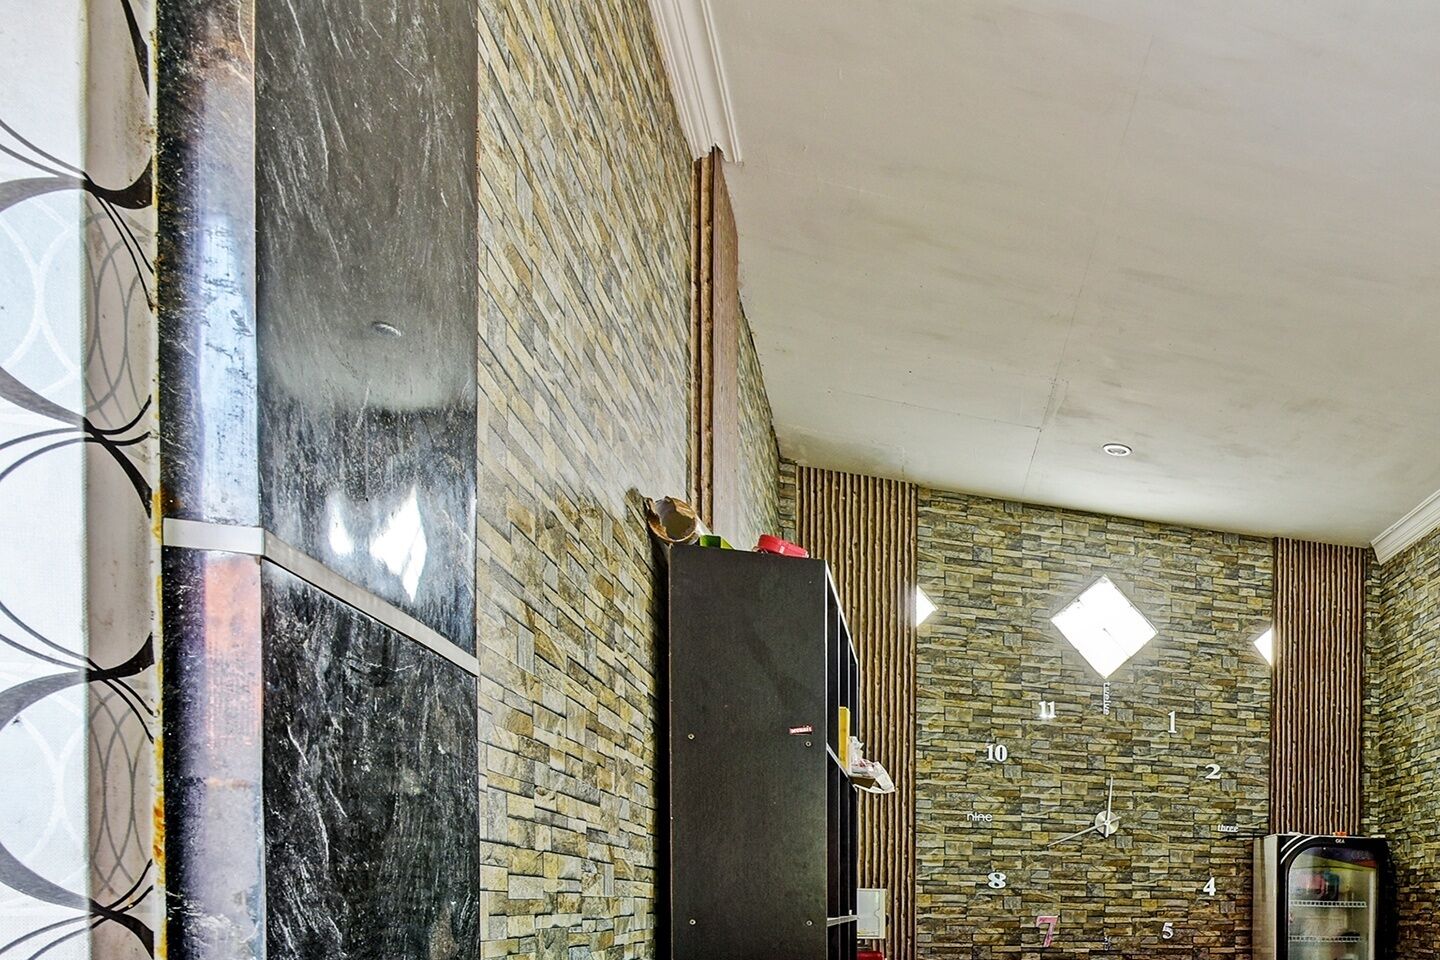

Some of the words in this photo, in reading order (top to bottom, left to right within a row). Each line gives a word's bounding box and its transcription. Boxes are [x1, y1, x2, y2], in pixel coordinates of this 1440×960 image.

[1039, 700, 1056, 718] 11
[1168, 710, 1177, 734] 1
[986, 744, 1008, 762] 10
[1205, 764, 1222, 780] 2
[988, 872, 1007, 888] 8
[1203, 877, 1216, 896] 4
[1036, 916, 1058, 947] 7
[1162, 922, 1174, 939] 5
